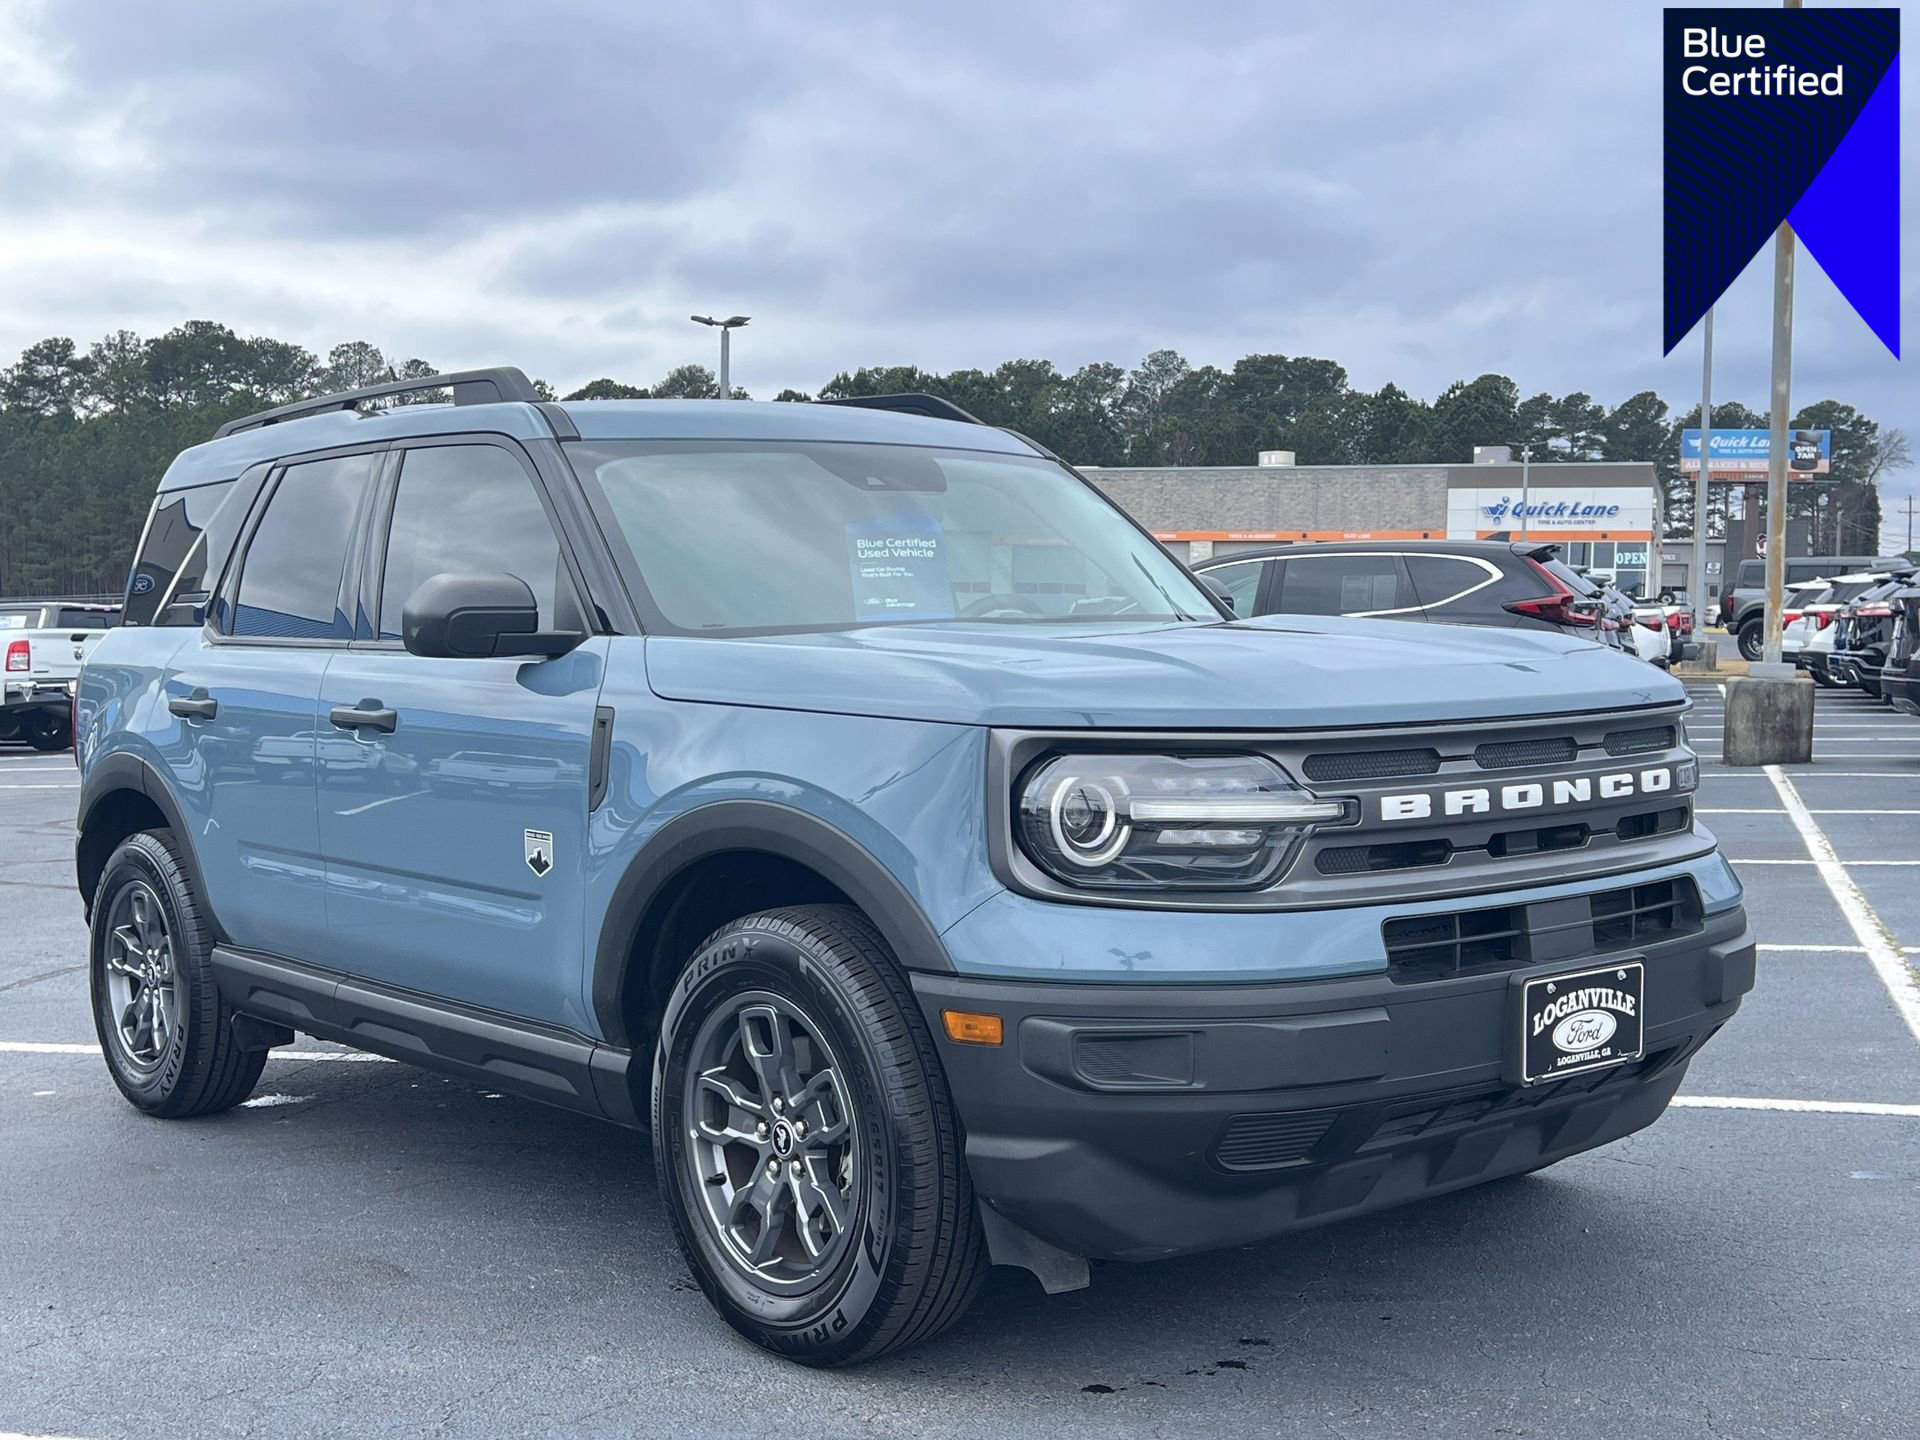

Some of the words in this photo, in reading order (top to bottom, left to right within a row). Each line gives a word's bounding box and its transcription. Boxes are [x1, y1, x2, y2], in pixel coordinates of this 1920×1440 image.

[1709, 435, 1749, 448] Quick
[1749, 436, 1771, 448] La
[1511, 502, 1568, 518] Quick
[1569, 502, 1620, 517] Lane
[856, 539, 884, 549] Blue
[886, 538, 937, 548] Certified
[857, 549, 889, 558] Used
[891, 549, 934, 557] Vehicle
[1616, 552, 1647, 565] OPEN
[1380, 768, 1671, 821] BRONCO
[1532, 987, 1636, 1037] LOGANVILLE
[1567, 1018, 1603, 1045] Ford
[1556, 1051, 1601, 1066] LOGANVILLE,
[1601, 1046, 1612, 1056] GA
[780, 1307, 849, 1345] PRIN
